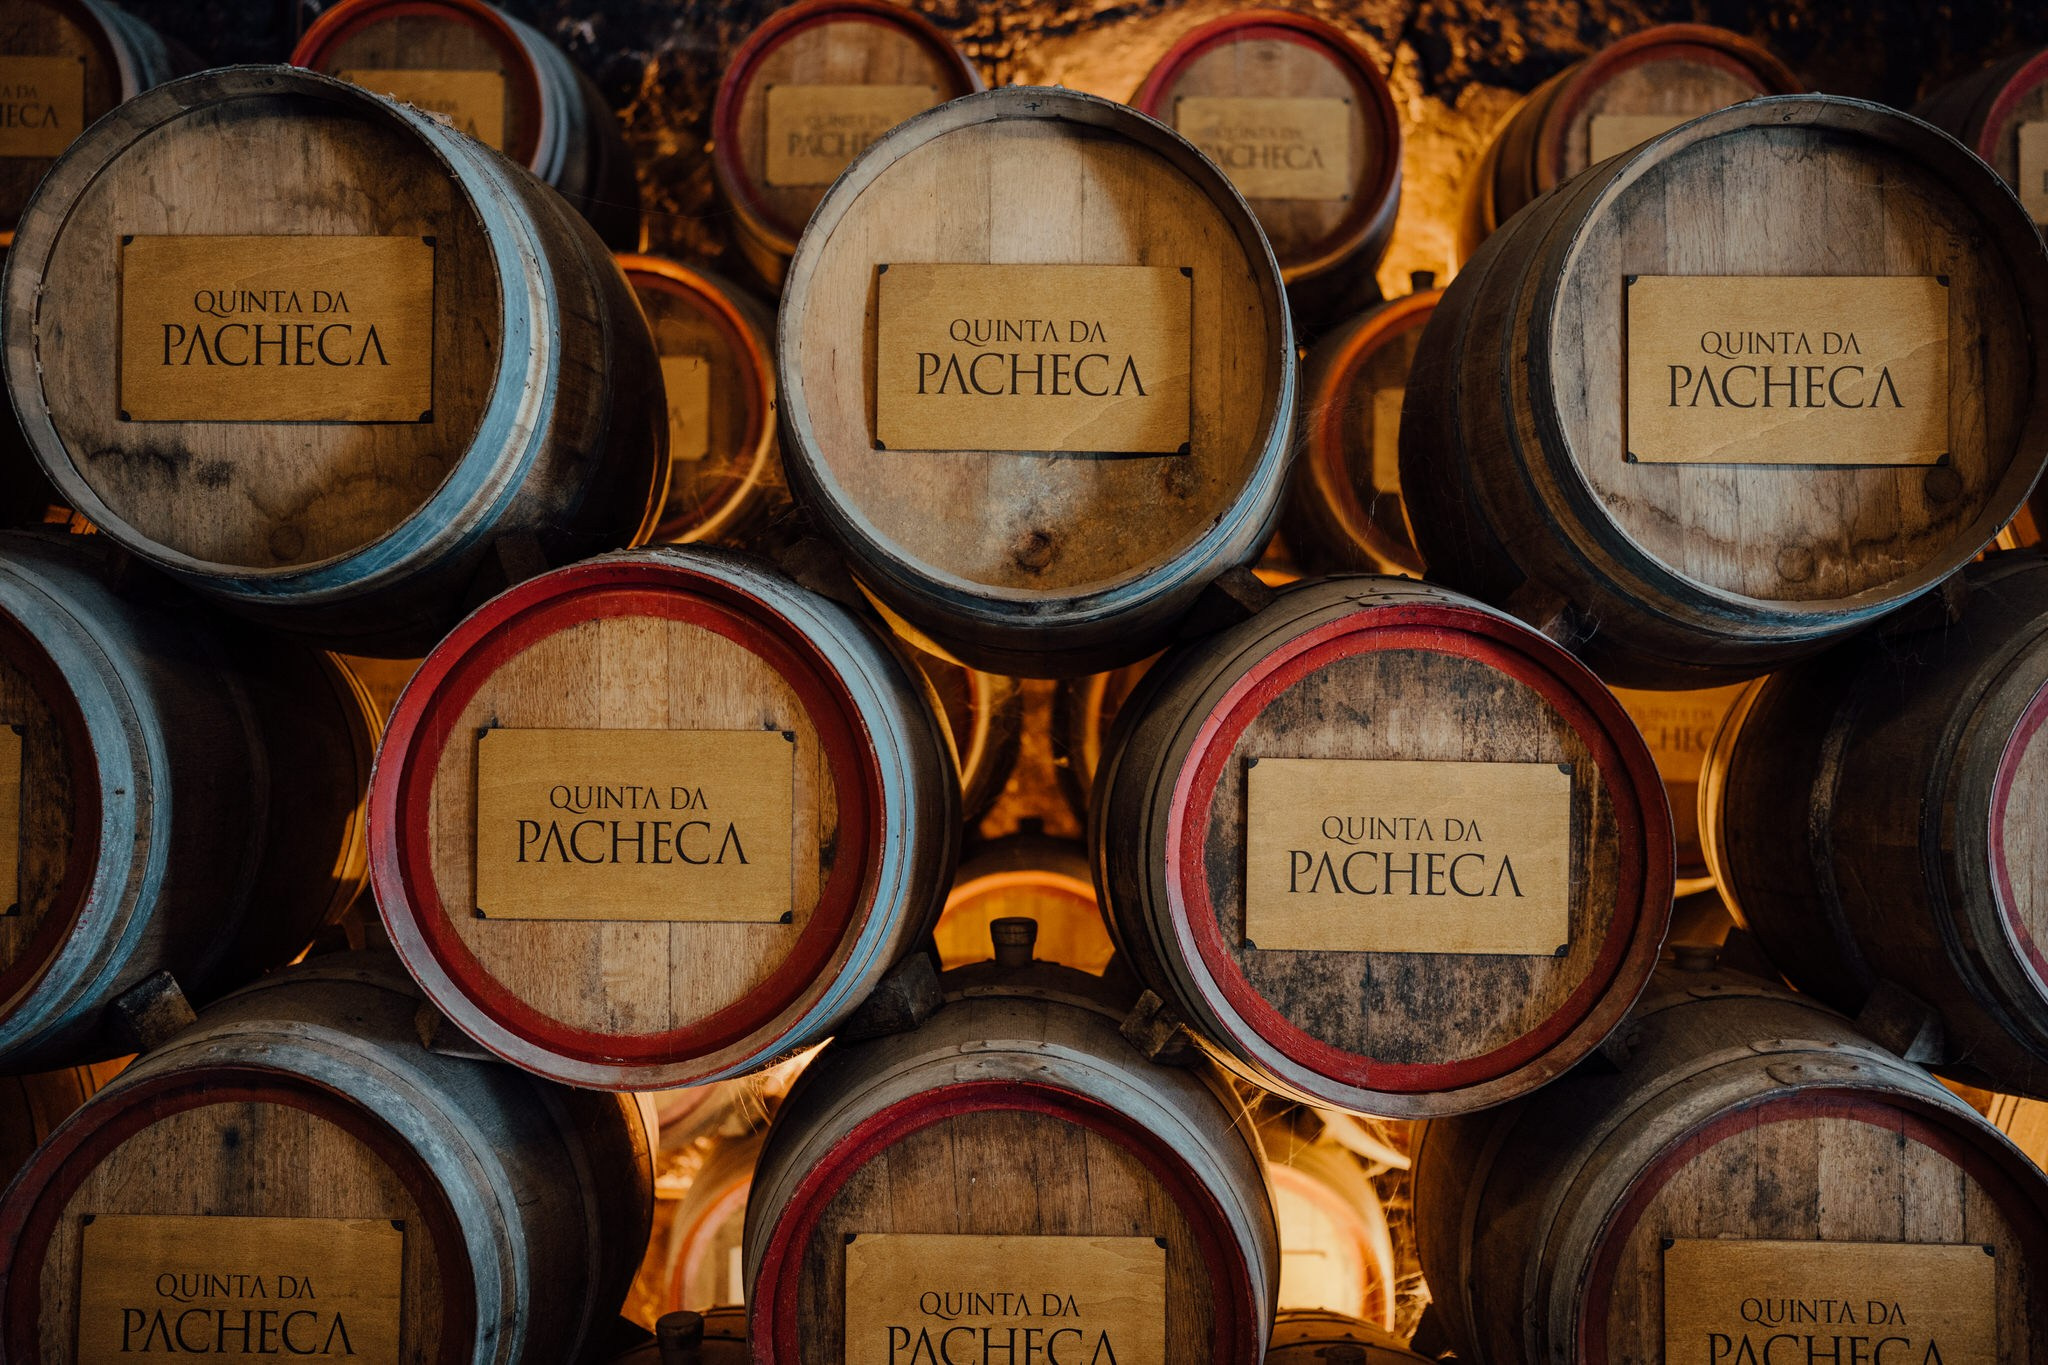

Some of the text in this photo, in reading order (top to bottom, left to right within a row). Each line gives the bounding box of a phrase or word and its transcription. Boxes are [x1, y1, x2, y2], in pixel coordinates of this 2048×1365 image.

[194, 289, 350, 319] QUINTA DA
[161, 323, 392, 367] PACHECA
[949, 318, 1107, 348] QUINTA DA
[1700, 330, 1862, 360] QUINTA DA
[915, 352, 1149, 397] PACHECA
[1667, 364, 1905, 409] PACHECA
[549, 785, 709, 815] QUINTA DA
[515, 819, 751, 865] PACHECA
[1321, 815, 1483, 846] QUINTA DA
[1287, 850, 1526, 898] PACHECA
[155, 1272, 316, 1304] QUINTA DA
[919, 1291, 1081, 1321] QUINTA DA
[1740, 1297, 1907, 1329] QUINTA DA
[119, 1307, 357, 1356] PACHECA
[885, 1326, 1118, 1365] PACHECA
